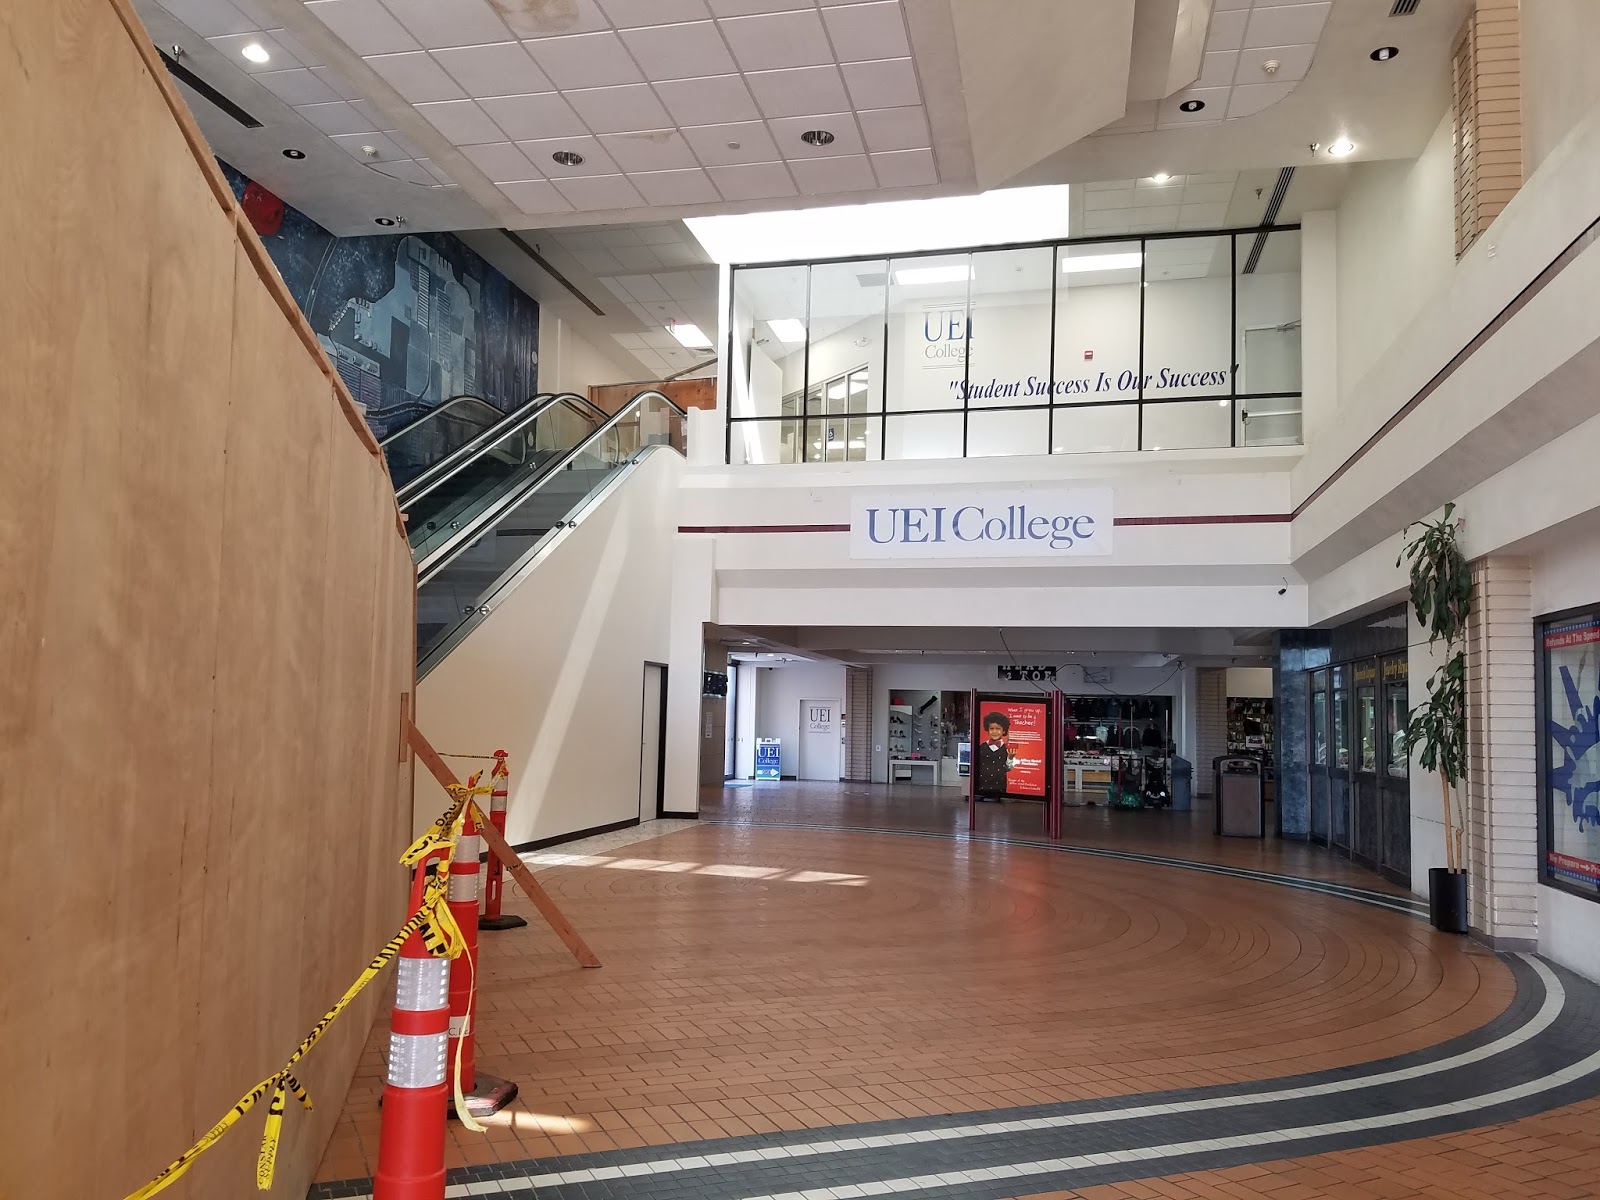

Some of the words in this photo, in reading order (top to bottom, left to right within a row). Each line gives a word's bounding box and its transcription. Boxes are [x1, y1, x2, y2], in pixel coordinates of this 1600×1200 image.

[922, 309, 976, 342] UEI
[924, 344, 974, 363] College
[1023, 376, 1090, 397] Success
[1095, 371, 1112, 392] Is
[1117, 369, 1153, 391] Our
[865, 506, 947, 544] UEI
[951, 504, 1096, 550] College
[1572, 632, 1583, 643] The
[1583, 628, 1600, 642] Speed
[810, 709, 830, 722] UEI
[758, 748, 780, 758] UEI
[1558, 855, 1580, 869] Prepare
